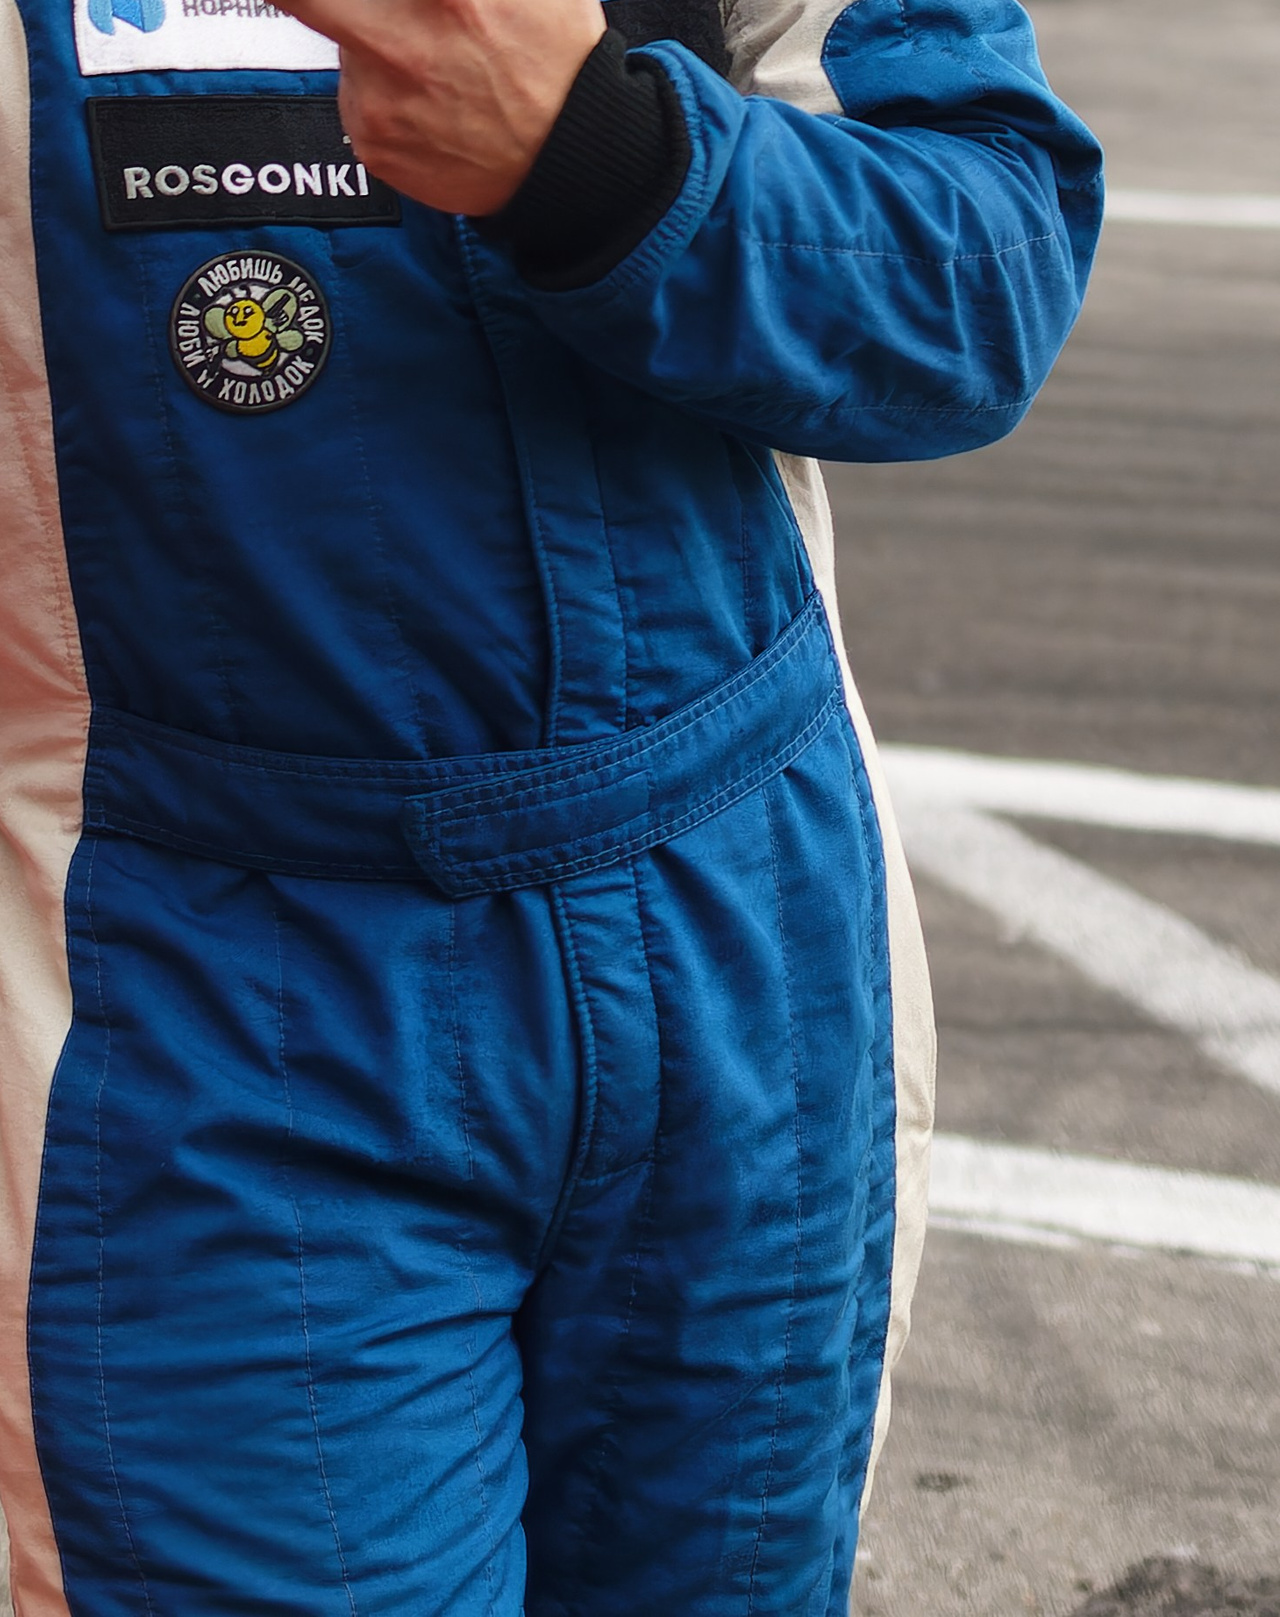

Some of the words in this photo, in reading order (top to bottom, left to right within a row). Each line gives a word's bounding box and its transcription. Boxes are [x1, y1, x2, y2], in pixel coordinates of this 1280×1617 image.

[123, 162, 369, 200] ROSGONKI
[197, 257, 284, 297] ЛЮБИШЬ
[177, 302, 206, 369] ЛЮБИ
[218, 355, 315, 405] ХОЛОДОК
